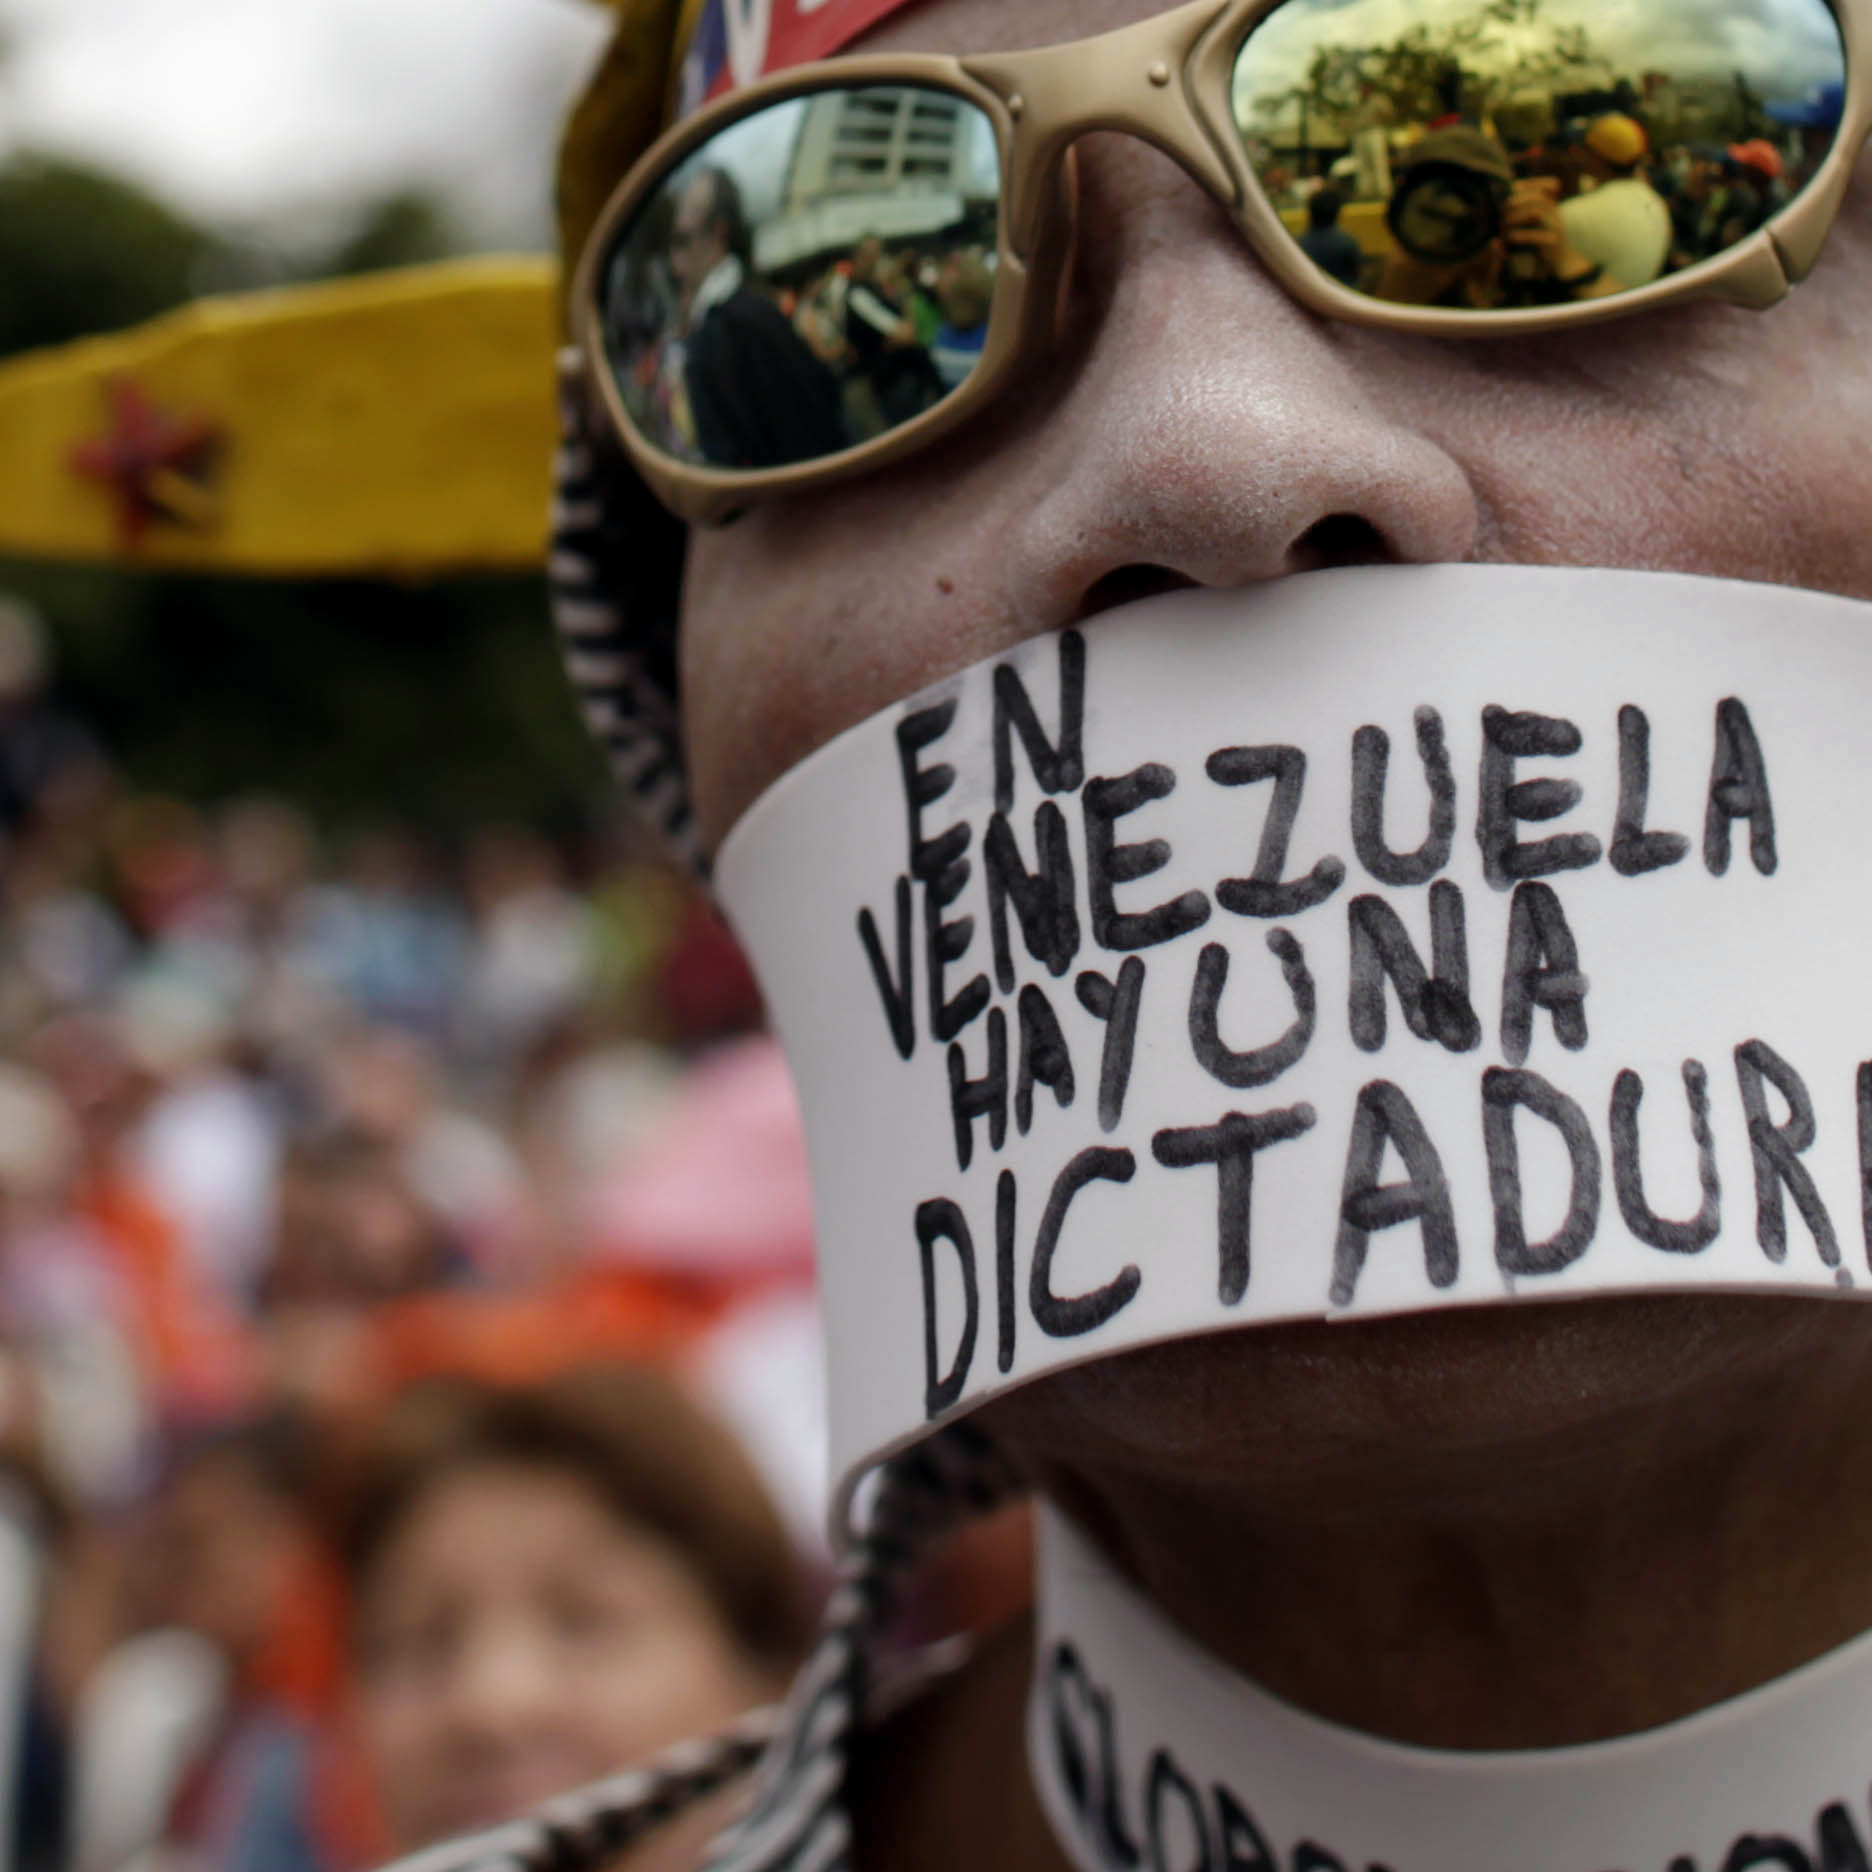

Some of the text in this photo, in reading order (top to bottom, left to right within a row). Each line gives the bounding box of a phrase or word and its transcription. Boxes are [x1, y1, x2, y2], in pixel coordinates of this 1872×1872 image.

[857, 695, 1779, 1062] VENEZUELA
[896, 630, 1085, 883] EN
[947, 879, 1591, 1171] HAY UNA
